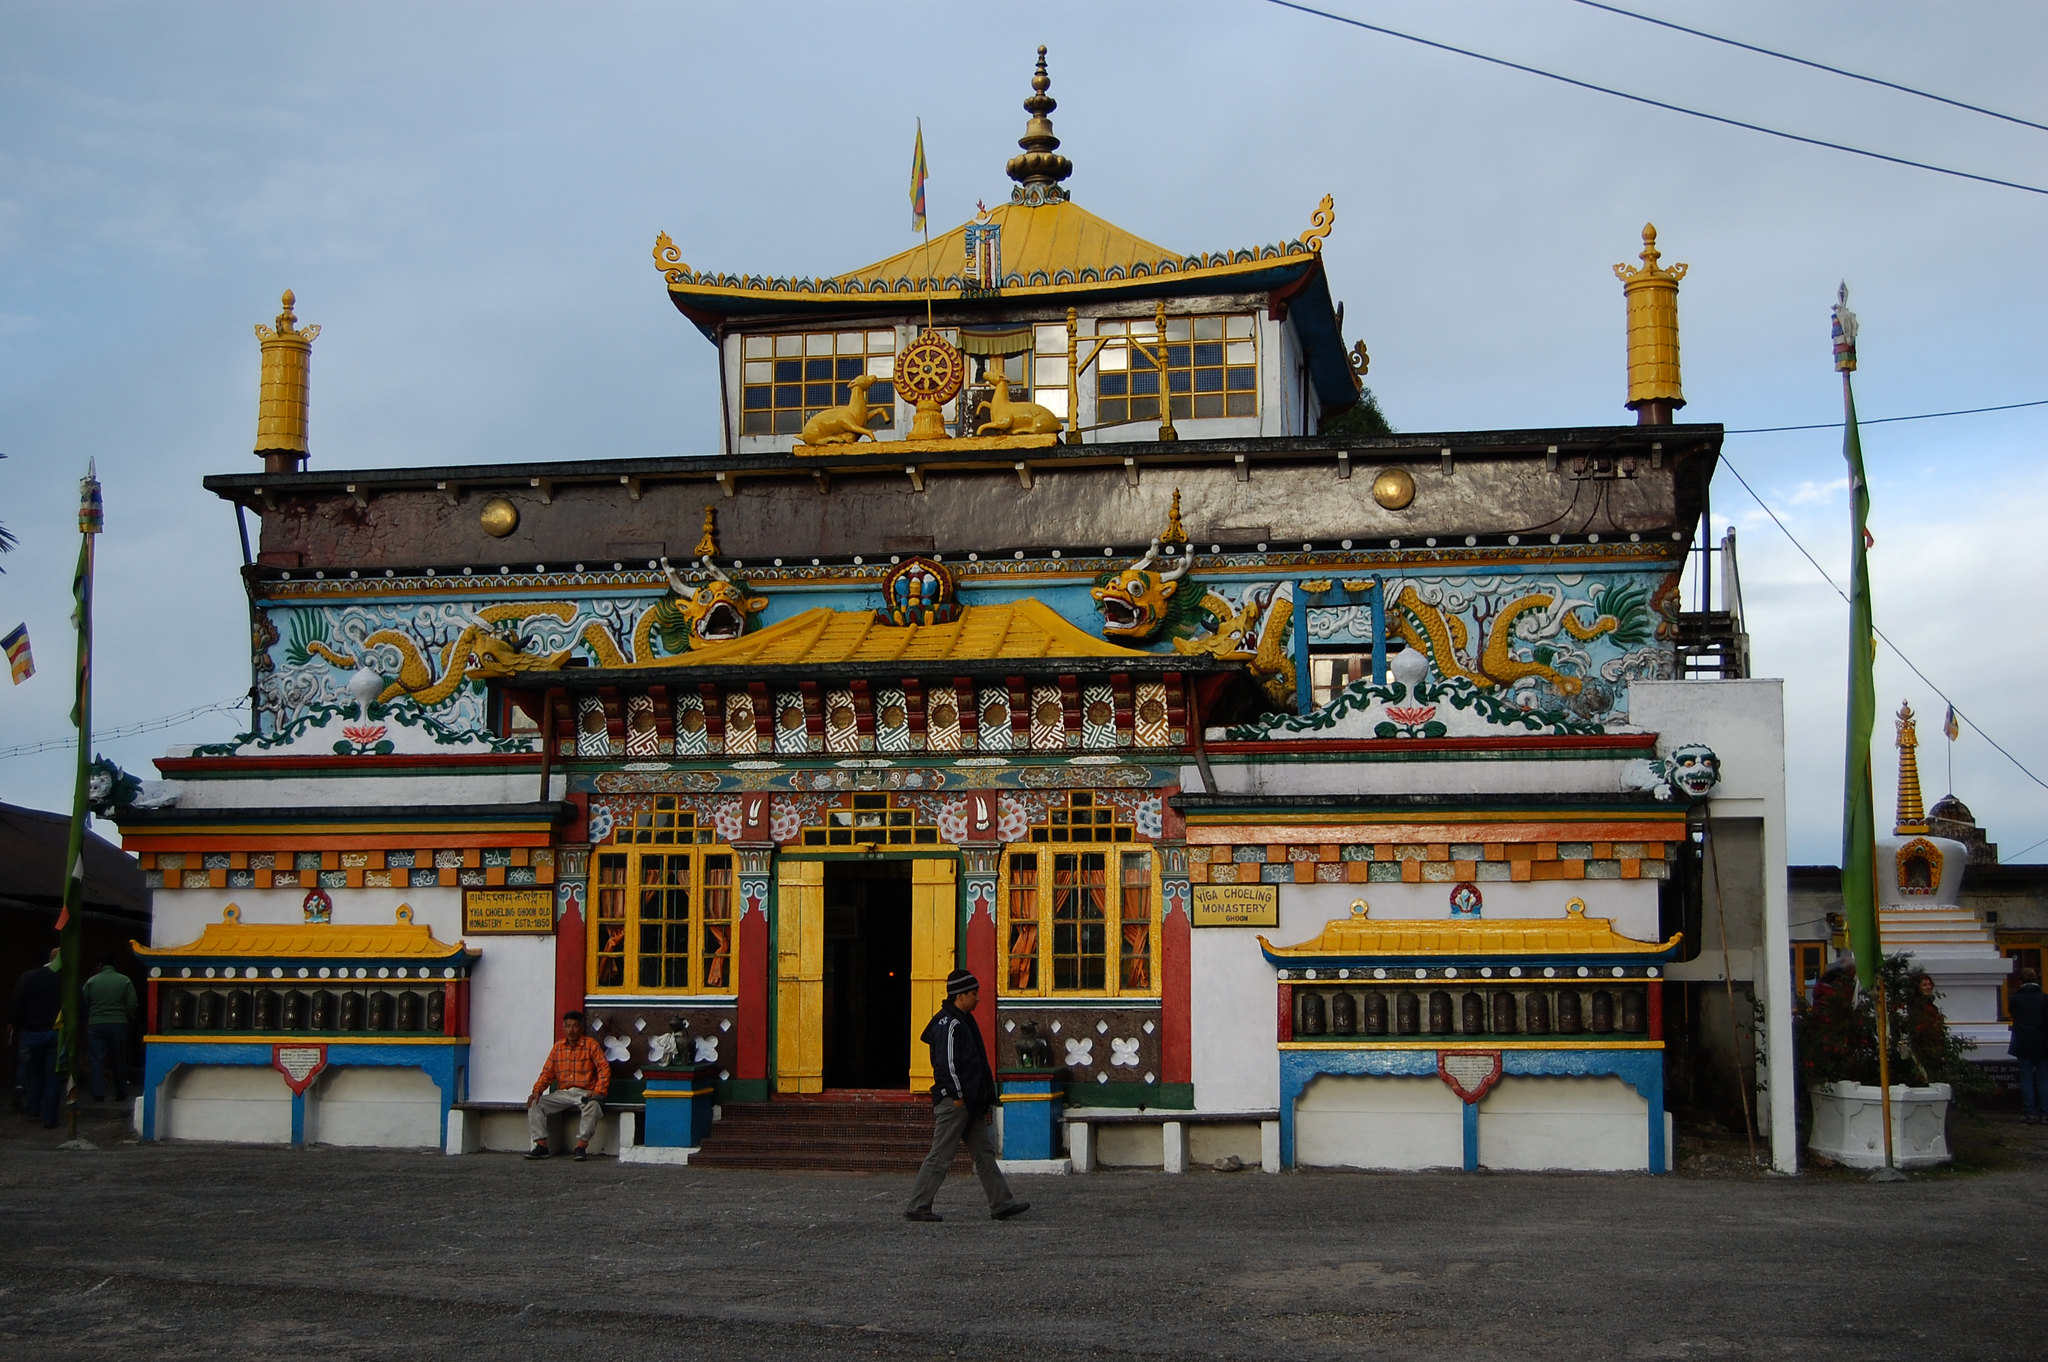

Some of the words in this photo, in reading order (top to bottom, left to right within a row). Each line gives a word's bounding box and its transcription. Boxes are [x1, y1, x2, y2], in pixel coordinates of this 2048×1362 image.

[1196, 889, 1218, 903] YIGA
[1224, 888, 1272, 902] CHOELING
[485, 907, 515, 917] CHOELING
[539, 907, 551, 917] OLD
[1202, 903, 1267, 913] MONASTERY
[469, 918, 502, 928] MONASTERY
